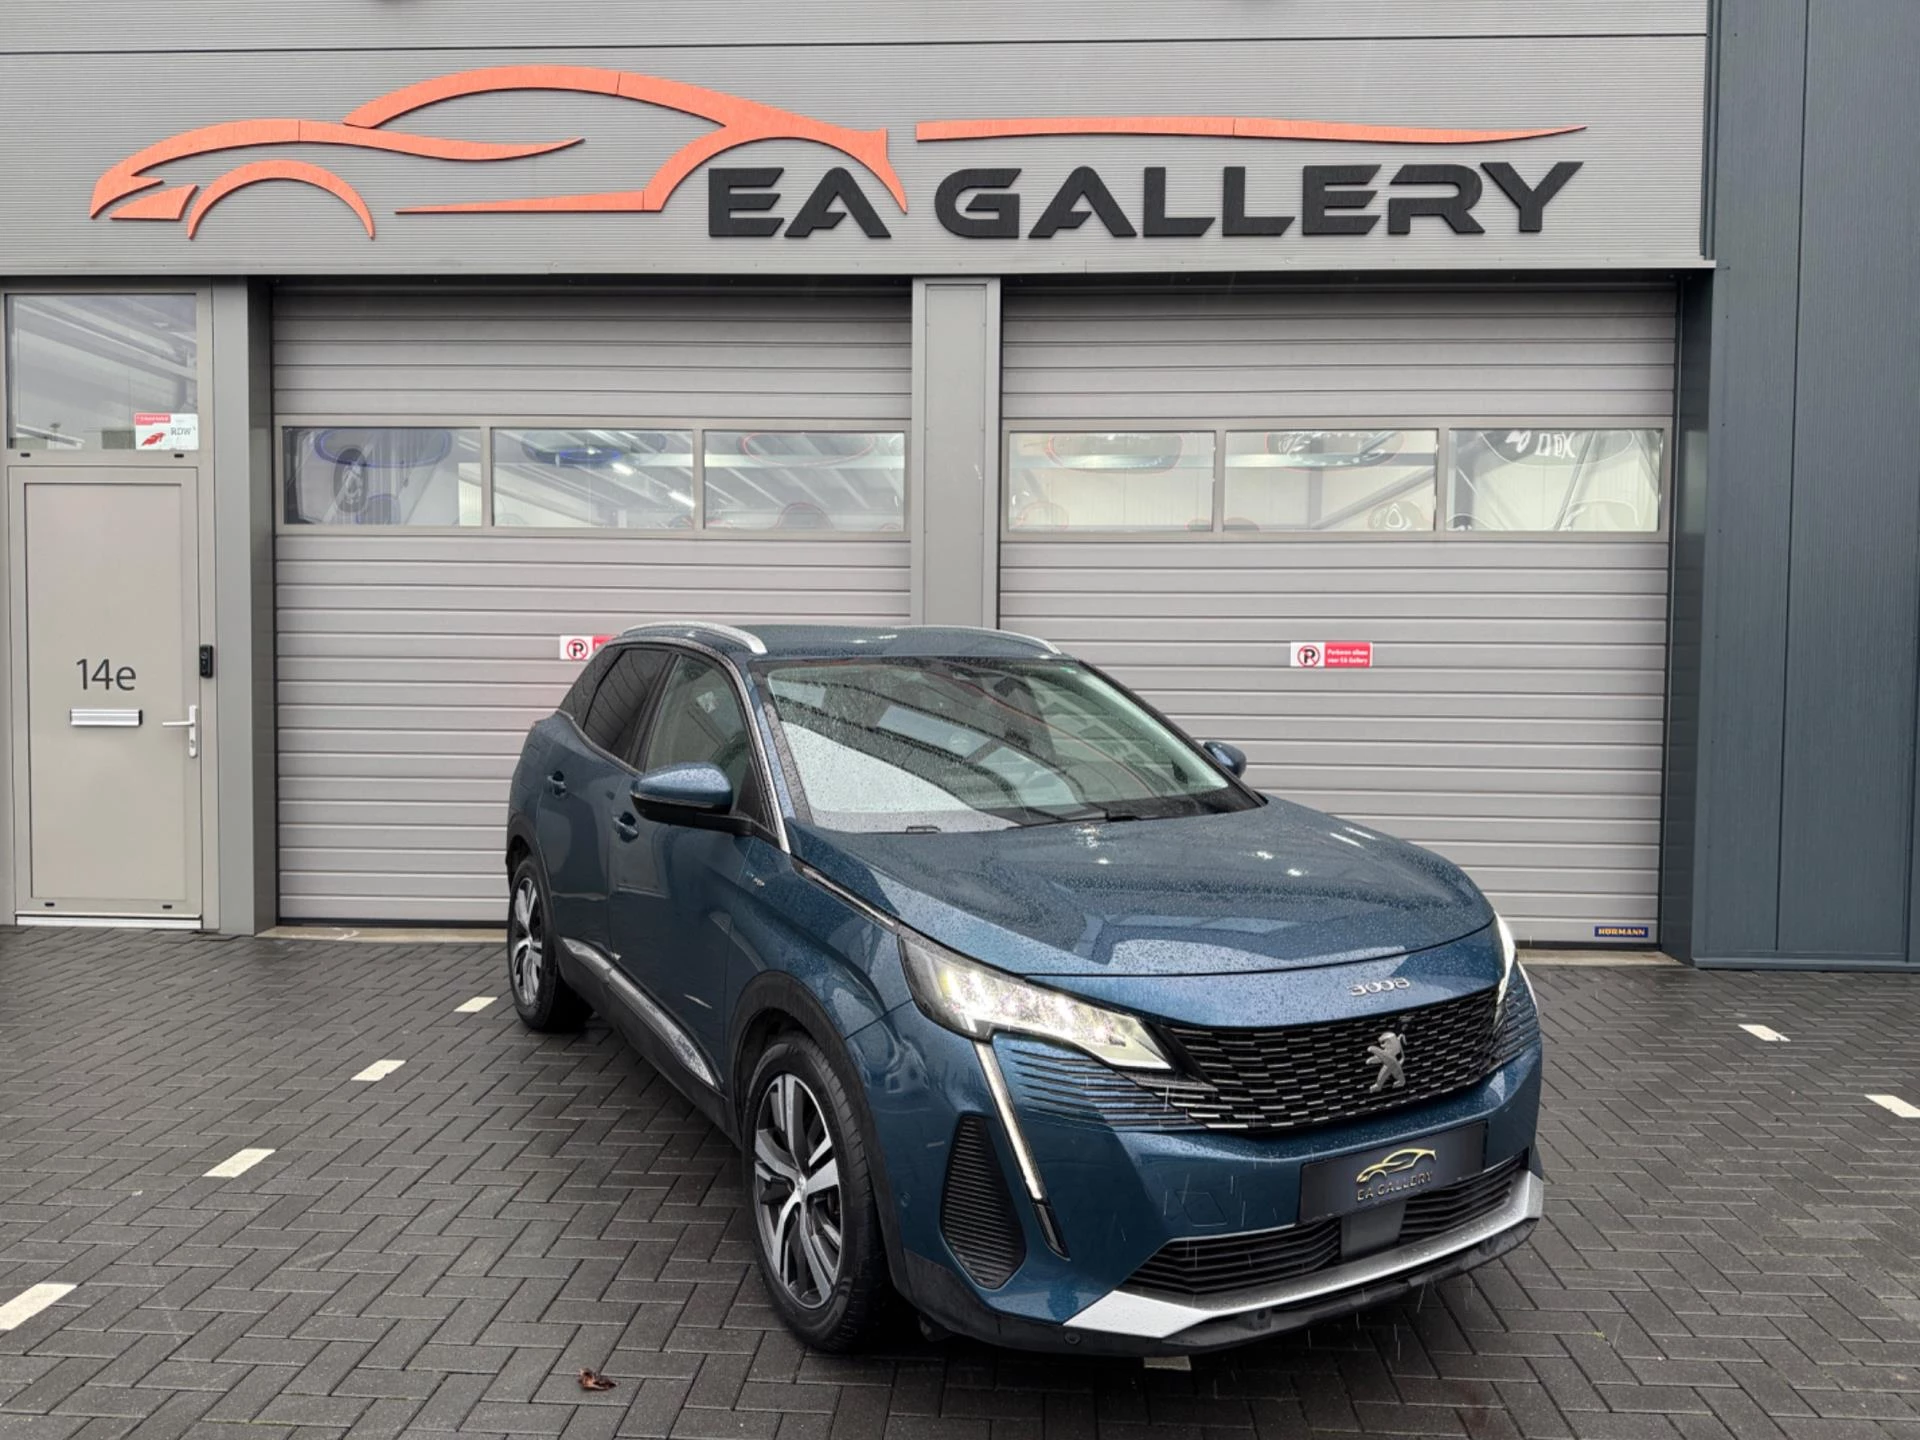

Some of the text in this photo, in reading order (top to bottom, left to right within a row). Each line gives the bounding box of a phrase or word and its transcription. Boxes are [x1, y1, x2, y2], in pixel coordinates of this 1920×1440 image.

[708, 161, 1584, 239] EA GALLERY
[76, 658, 137, 691] 14e
[1347, 977, 1410, 997] 3008
[1357, 1170, 1433, 1201] EA GALLERY
